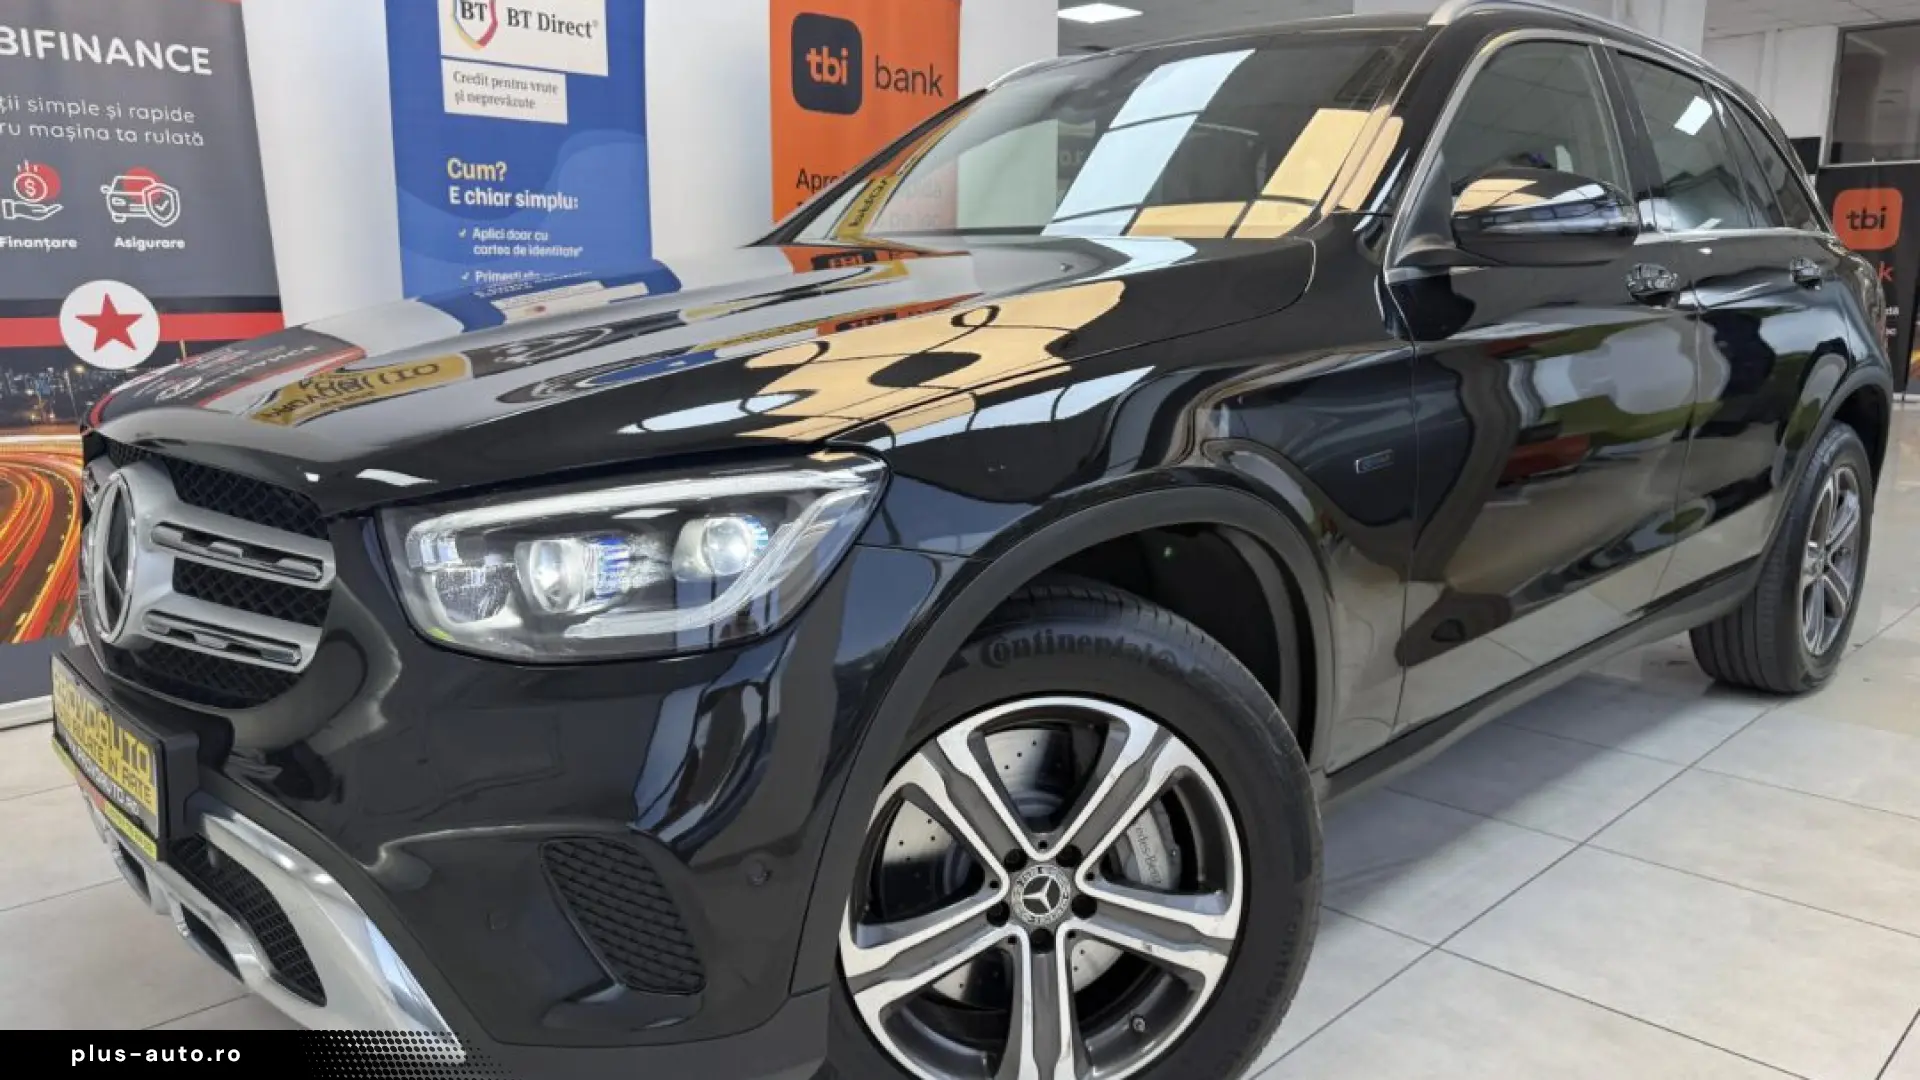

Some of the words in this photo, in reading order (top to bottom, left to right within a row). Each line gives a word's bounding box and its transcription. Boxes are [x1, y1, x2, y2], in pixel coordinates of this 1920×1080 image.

[460, 1, 487, 21] BT
[507, 7, 532, 29] BT
[806, 46, 848, 85] tbi
[875, 54, 944, 96] bank
[453, 71, 488, 86] Credit
[491, 77, 528, 90] pentru
[27, 97, 100, 117] simple
[128, 105, 196, 125] rapide
[29, 123, 110, 142] mașina
[116, 127, 138, 143] ta
[144, 128, 205, 147] rulată
[447, 158, 508, 181] Cum?
[449, 185, 461, 205] E
[464, 187, 512, 208] chiar
[515, 190, 579, 212] simplu:
[1846, 207, 1887, 230] tbi
[114, 236, 186, 252] Asigurare
[472, 227, 505, 241] Aplici
[506, 229, 531, 241] doar
[535, 231, 548, 241] cu
[473, 244, 510, 256] cartea
[512, 244, 527, 257] de
[980, 628, 1155, 669] Continental
